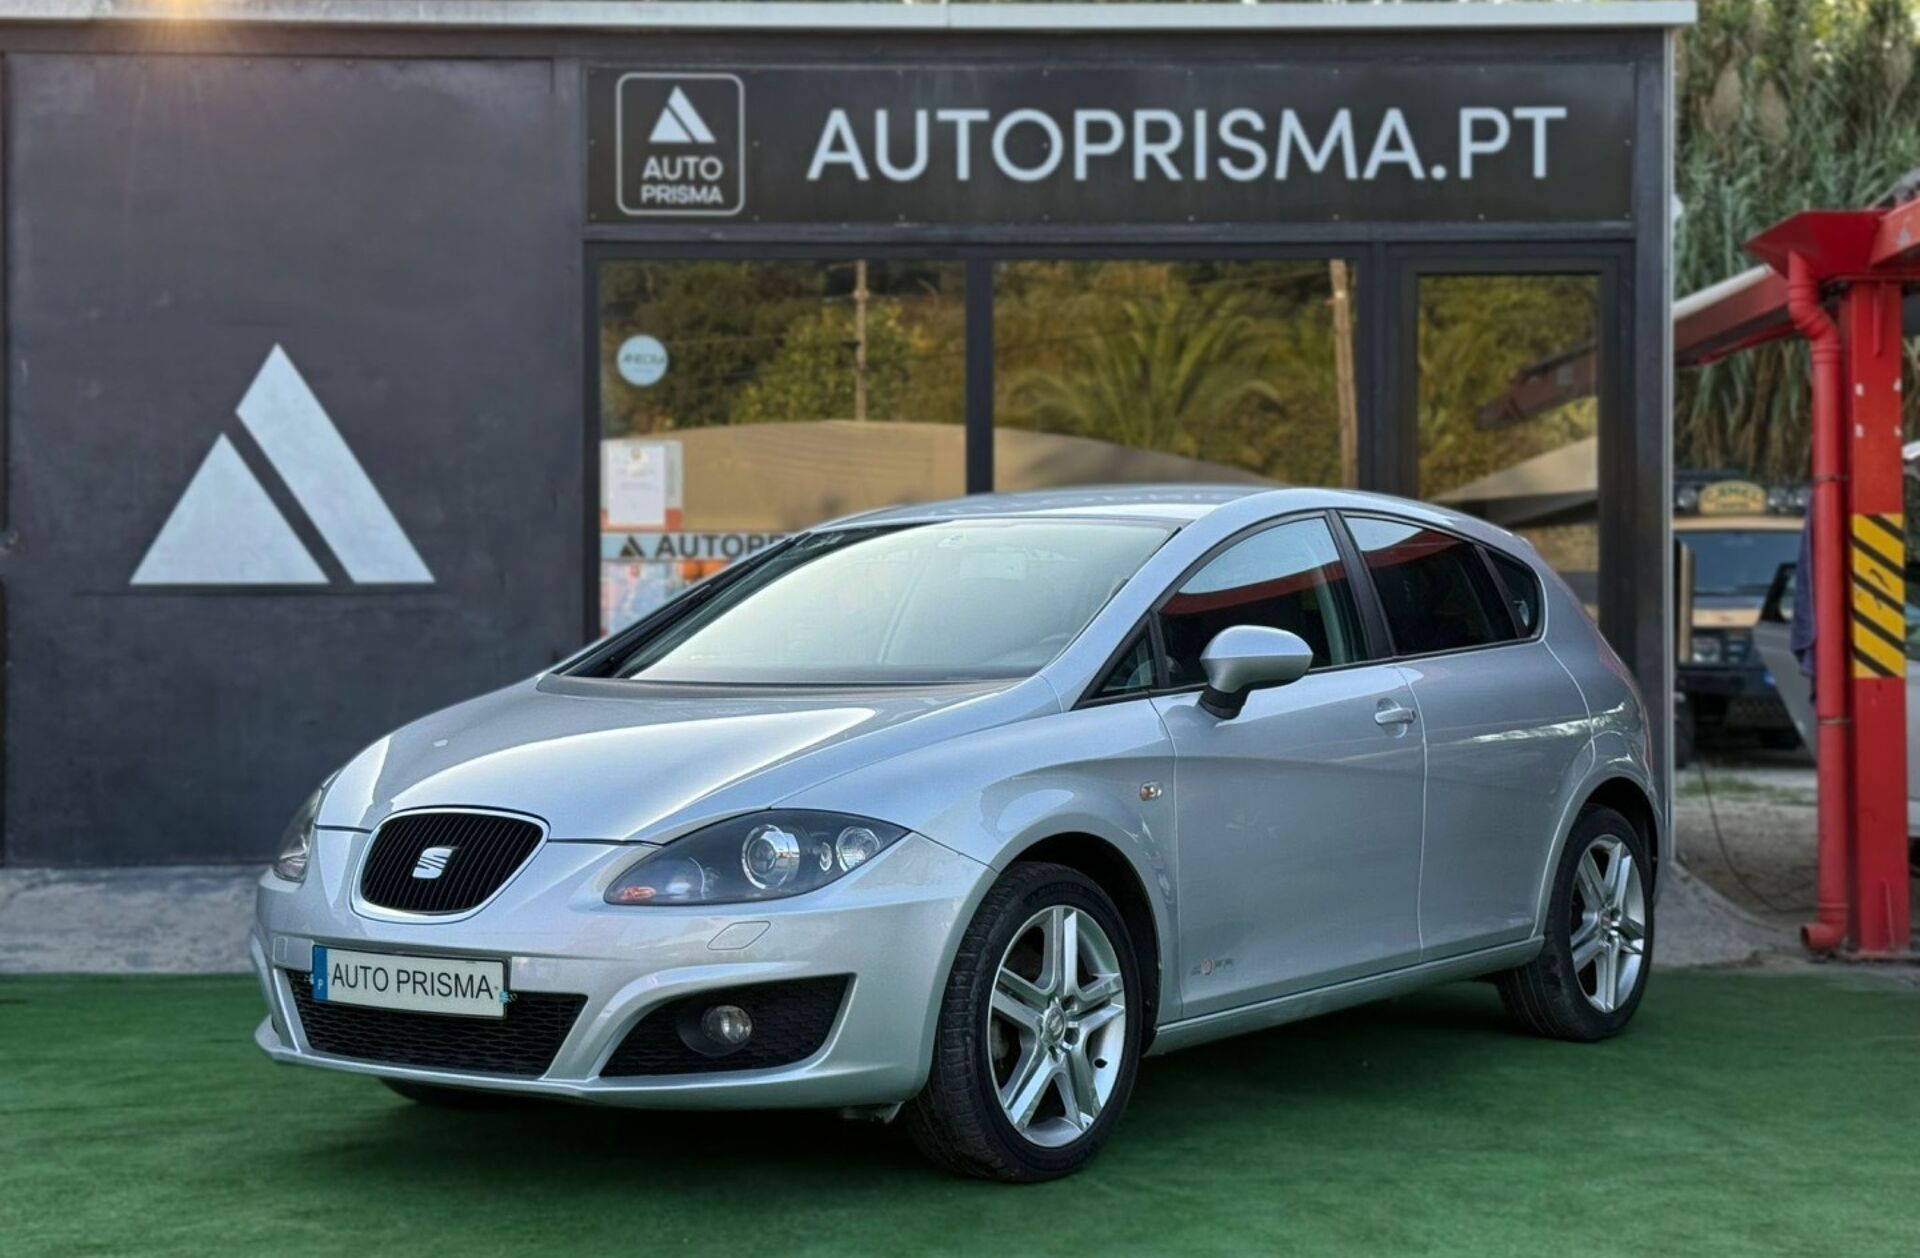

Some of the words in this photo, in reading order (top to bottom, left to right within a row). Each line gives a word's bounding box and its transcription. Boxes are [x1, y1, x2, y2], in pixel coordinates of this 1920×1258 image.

[807, 106, 1567, 182] AUTOPRISMA.PT
[642, 155, 723, 181] AUTO
[641, 184, 723, 204] PRISMA
[331, 962, 389, 993] AUTO
[396, 968, 493, 1000] PRISMA
